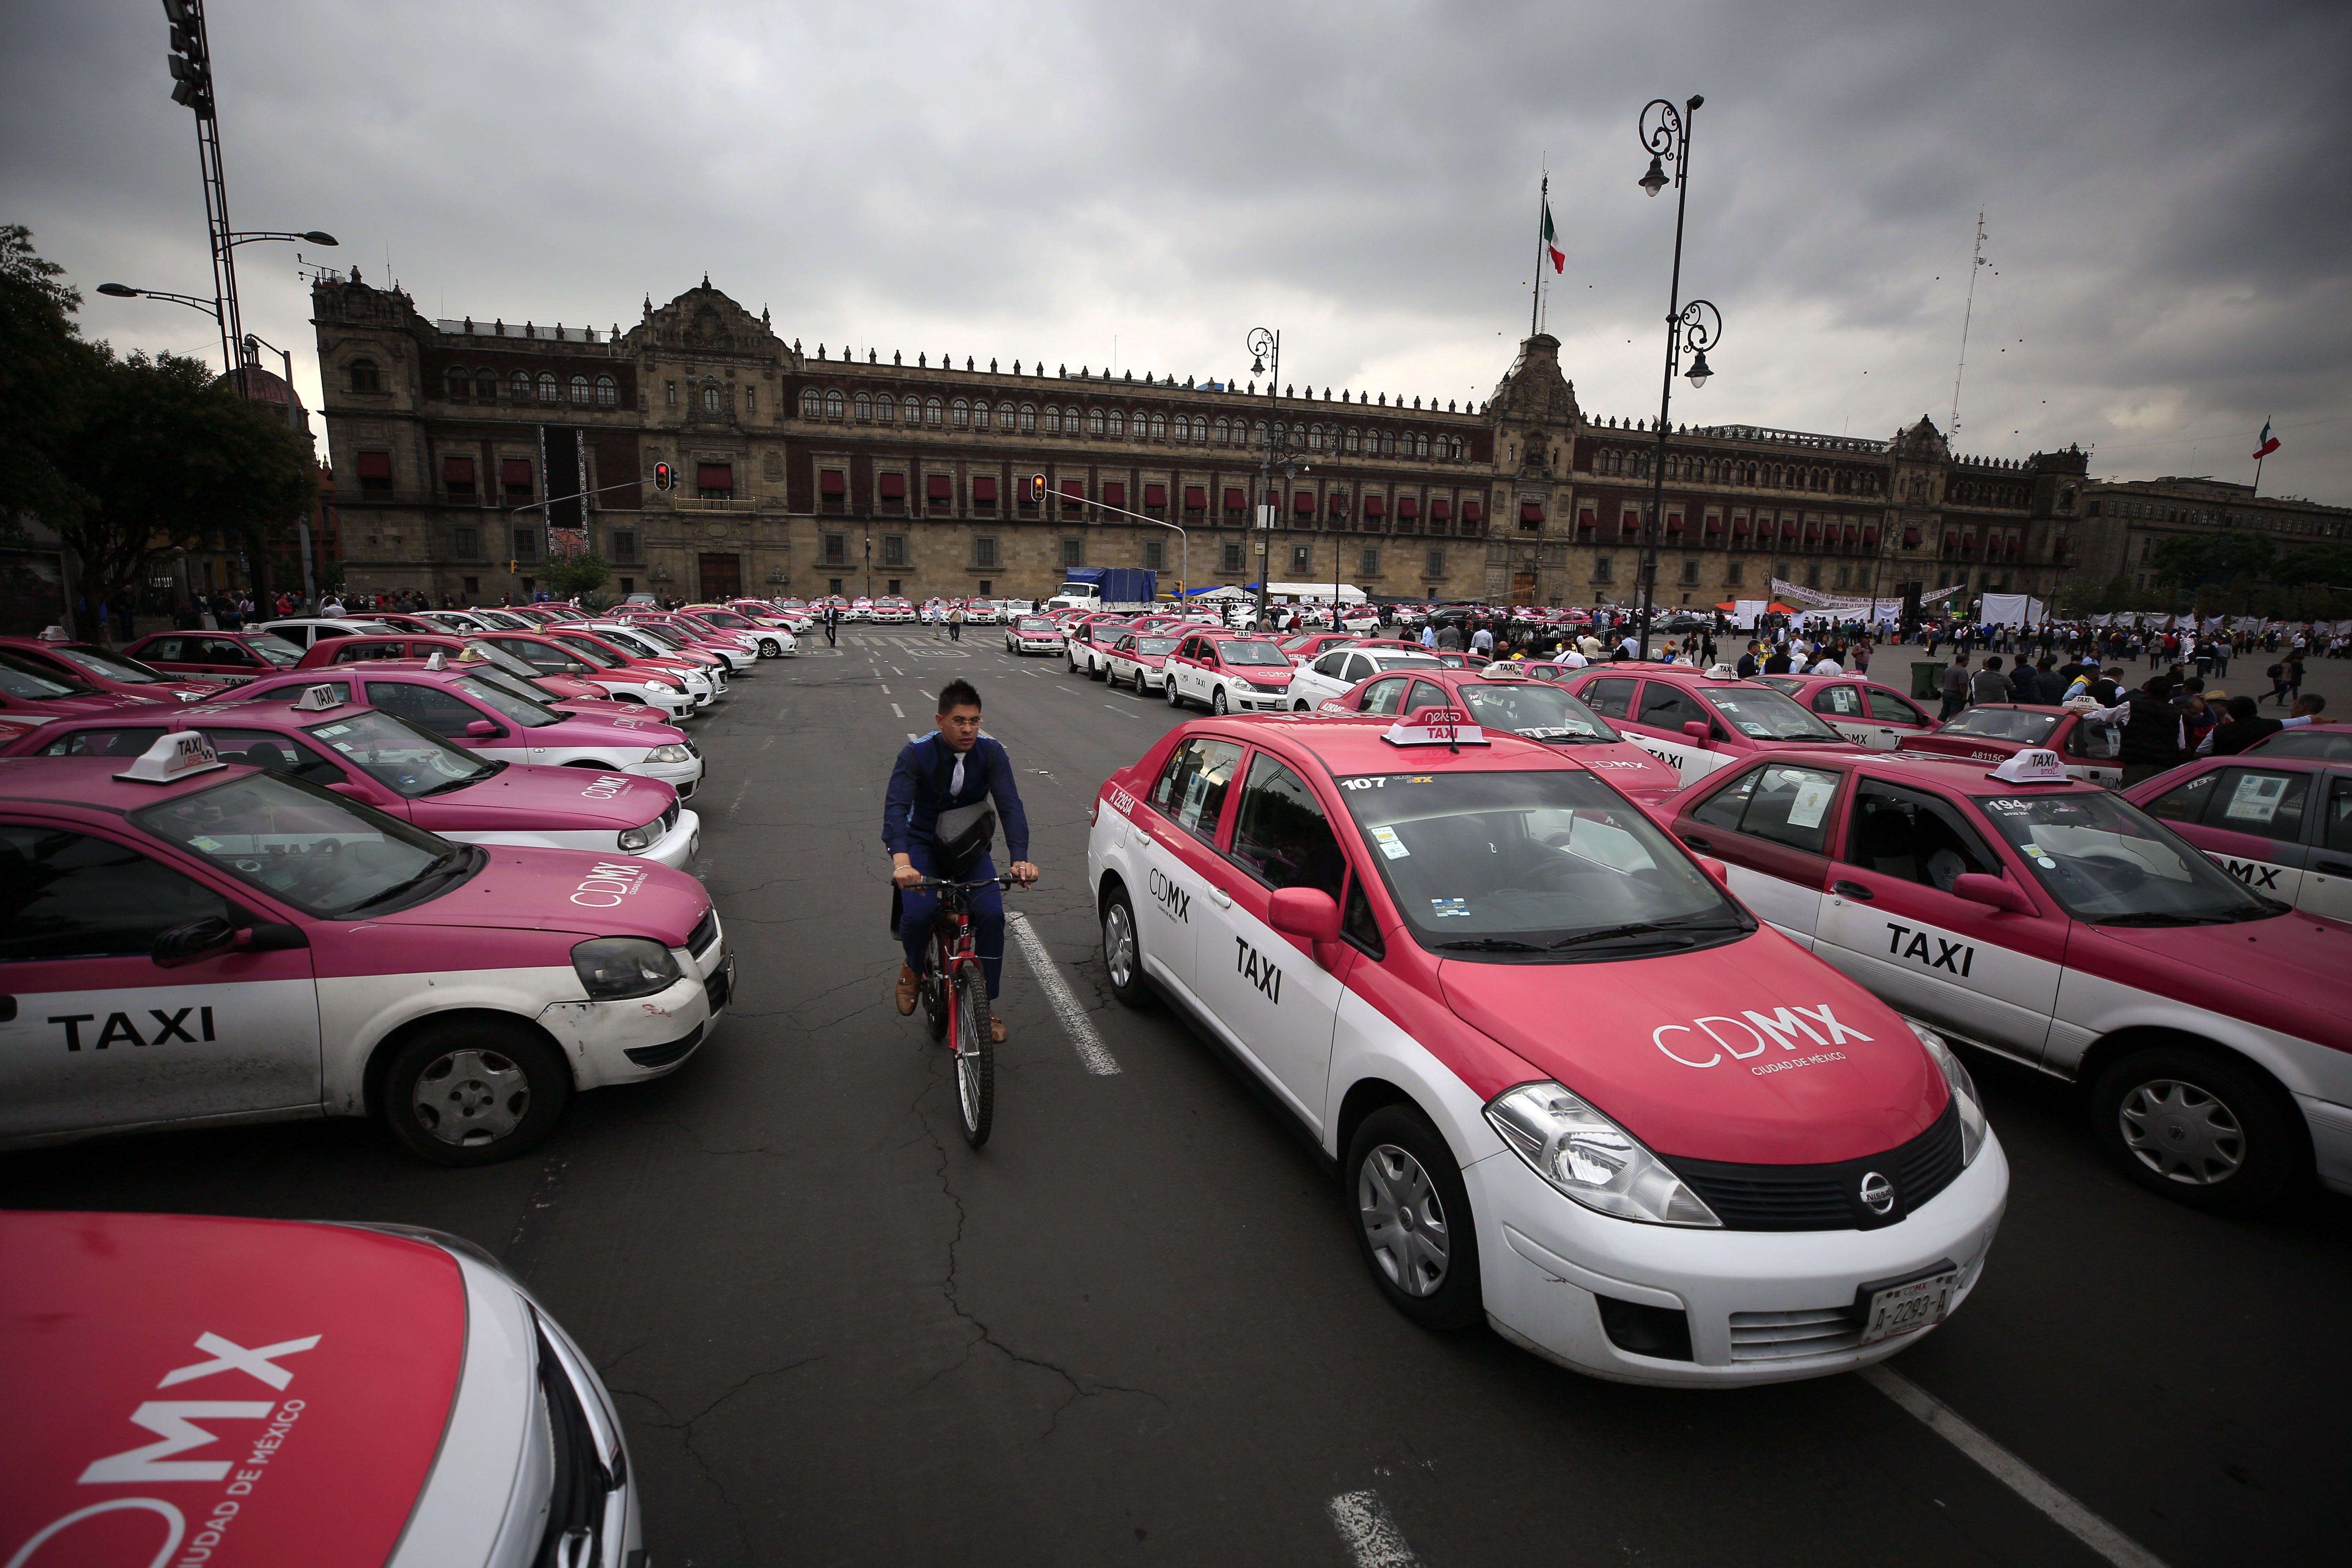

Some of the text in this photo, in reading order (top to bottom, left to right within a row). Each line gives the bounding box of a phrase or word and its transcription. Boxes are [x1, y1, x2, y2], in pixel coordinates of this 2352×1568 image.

[1179, 673, 1189, 682] CDMX
[1196, 678, 1205, 688] TAXI
[312, 686, 334, 706] TAXI
[1425, 709, 1461, 725] nekso
[1427, 728, 1458, 739] TAXI
[1841, 733, 1867, 744] DMX
[178, 737, 203, 756] TAXI
[184, 754, 202, 766] LIBRE
[1581, 761, 1651, 770] CDMX
[1647, 748, 1683, 770] TAXI
[1971, 751, 2005, 762] A8115C
[2032, 754, 2055, 767] TAXI
[581, 775, 630, 800] CDMX
[1341, 777, 1387, 791] 107
[2100, 777, 2123, 789] CDM
[1109, 788, 1135, 817] A 2293A
[1989, 799, 2026, 811] 194
[569, 862, 643, 907] CDMX
[2227, 860, 2282, 890] MX
[1149, 868, 1191, 924] CDMX
[1157, 904, 1166, 915] CIUDAD
[1887, 922, 1974, 978] TAXI
[1236, 935, 1282, 1005] TAXI
[47, 1006, 216, 1051] TAXI
[1652, 1004, 1875, 1069] CDMX
[1751, 1052, 1846, 1076] CIUDAD DE MÉXICO
[1866, 1188, 1894, 1201] NISSAN
[1904, 1282, 1927, 1296] CDMX
[1873, 1287, 1947, 1332] A-2293-A
[2, 1331, 323, 1568] DMX
[178, 1399, 306, 1568] IUDAD DE MÉXICO
